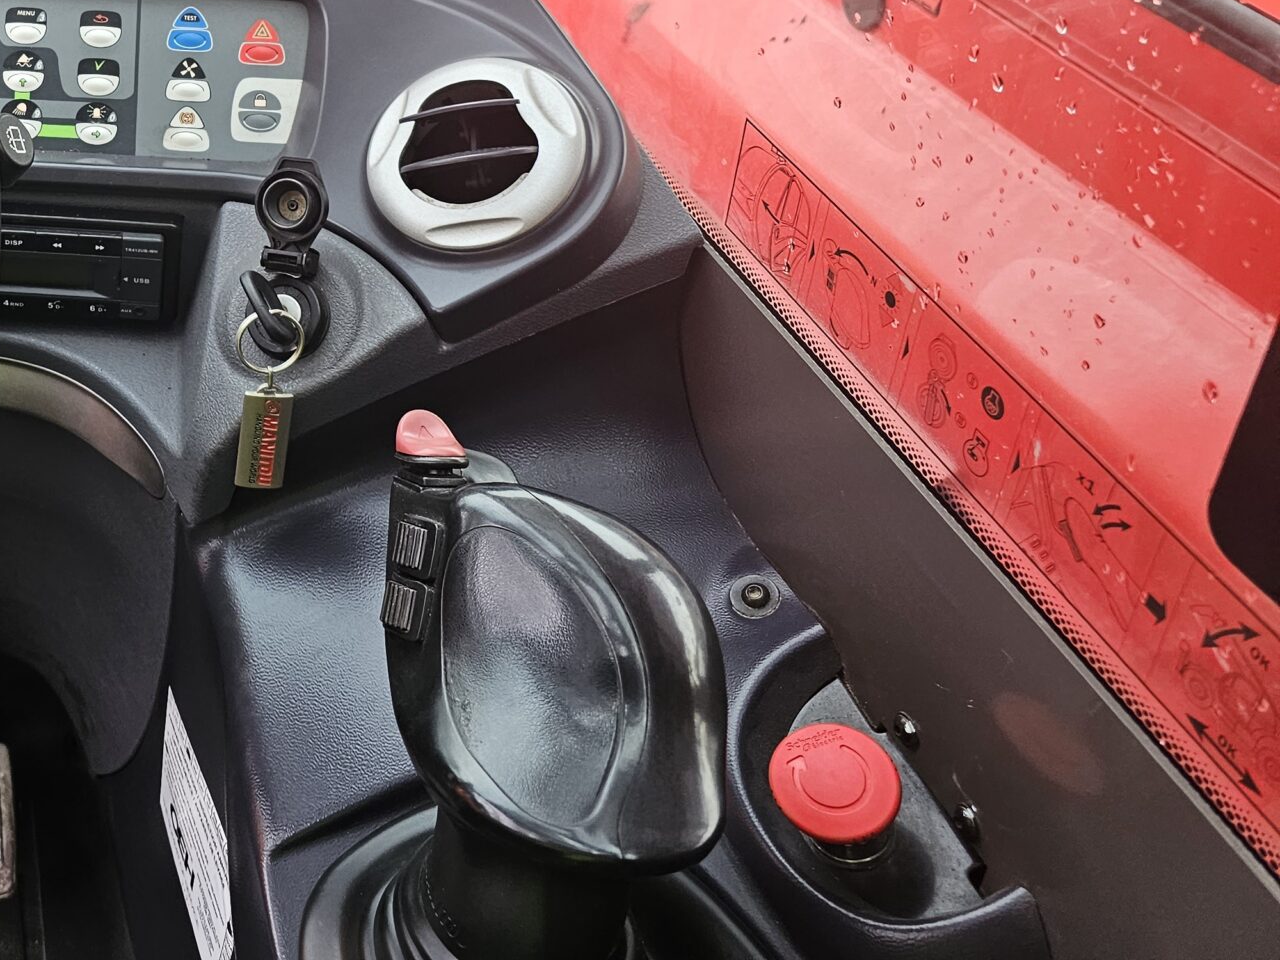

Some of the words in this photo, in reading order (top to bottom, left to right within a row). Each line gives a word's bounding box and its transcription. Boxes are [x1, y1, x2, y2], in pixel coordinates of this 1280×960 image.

[250, 445, 259, 462] YOUR
[257, 416, 279, 487] MANITOU
[248, 462, 257, 484] WORLD
[1250, 646, 1270, 672] OK
[785, 729, 840, 751] Schneider
[1217, 734, 1238, 760] OK
